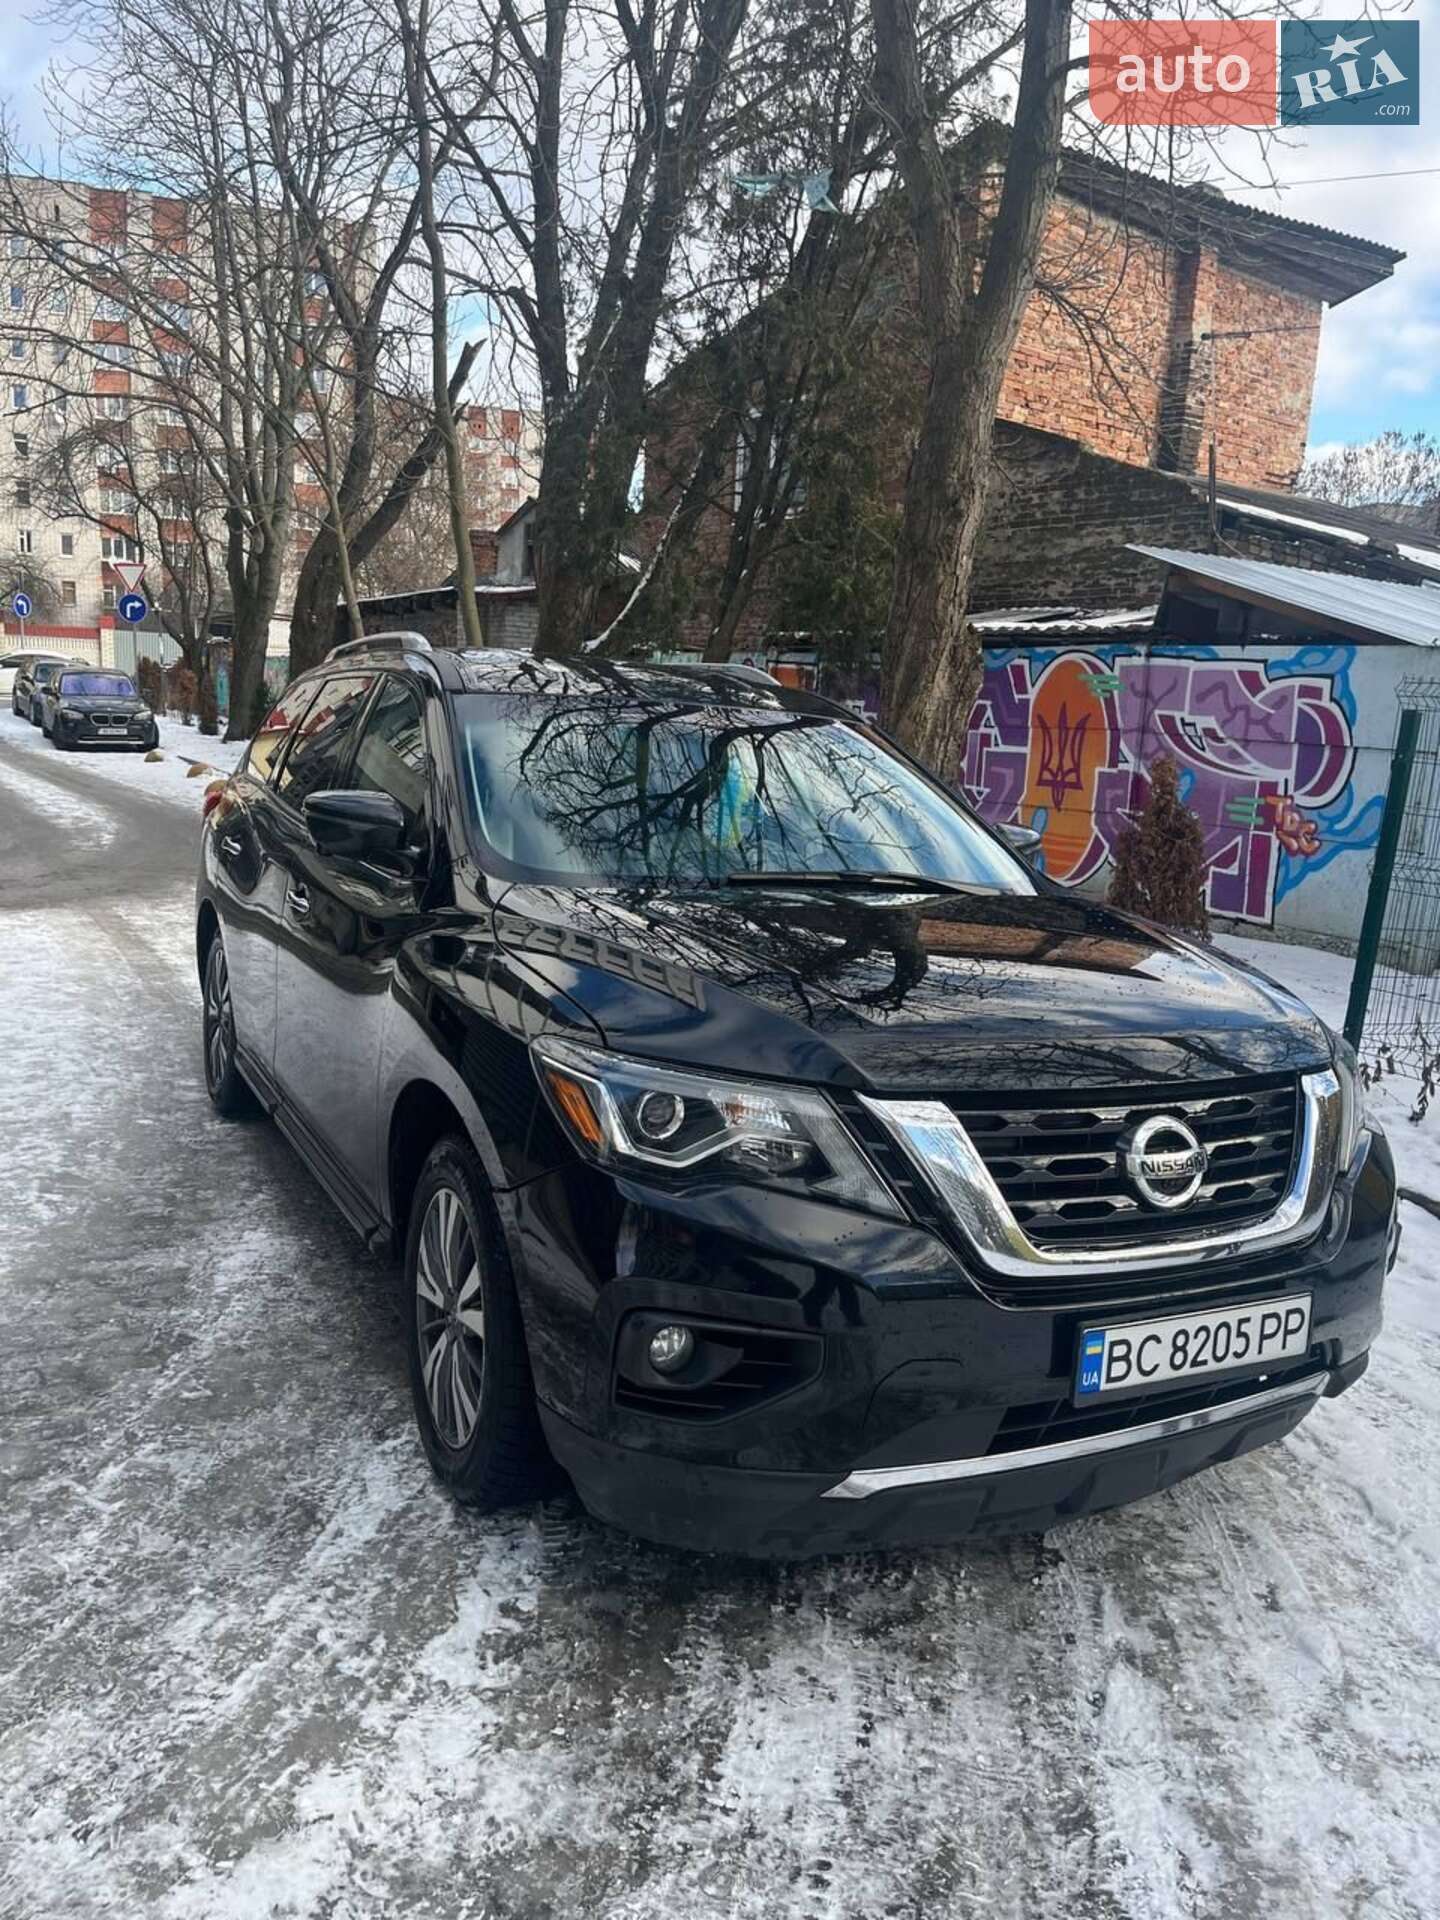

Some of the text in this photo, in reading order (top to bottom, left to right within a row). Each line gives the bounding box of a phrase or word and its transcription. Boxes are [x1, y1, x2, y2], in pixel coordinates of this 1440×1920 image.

[1140, 1153, 1204, 1173] NISSAN
[1170, 1317, 1251, 1371] 8205
[1082, 1374, 1099, 1386] UA
